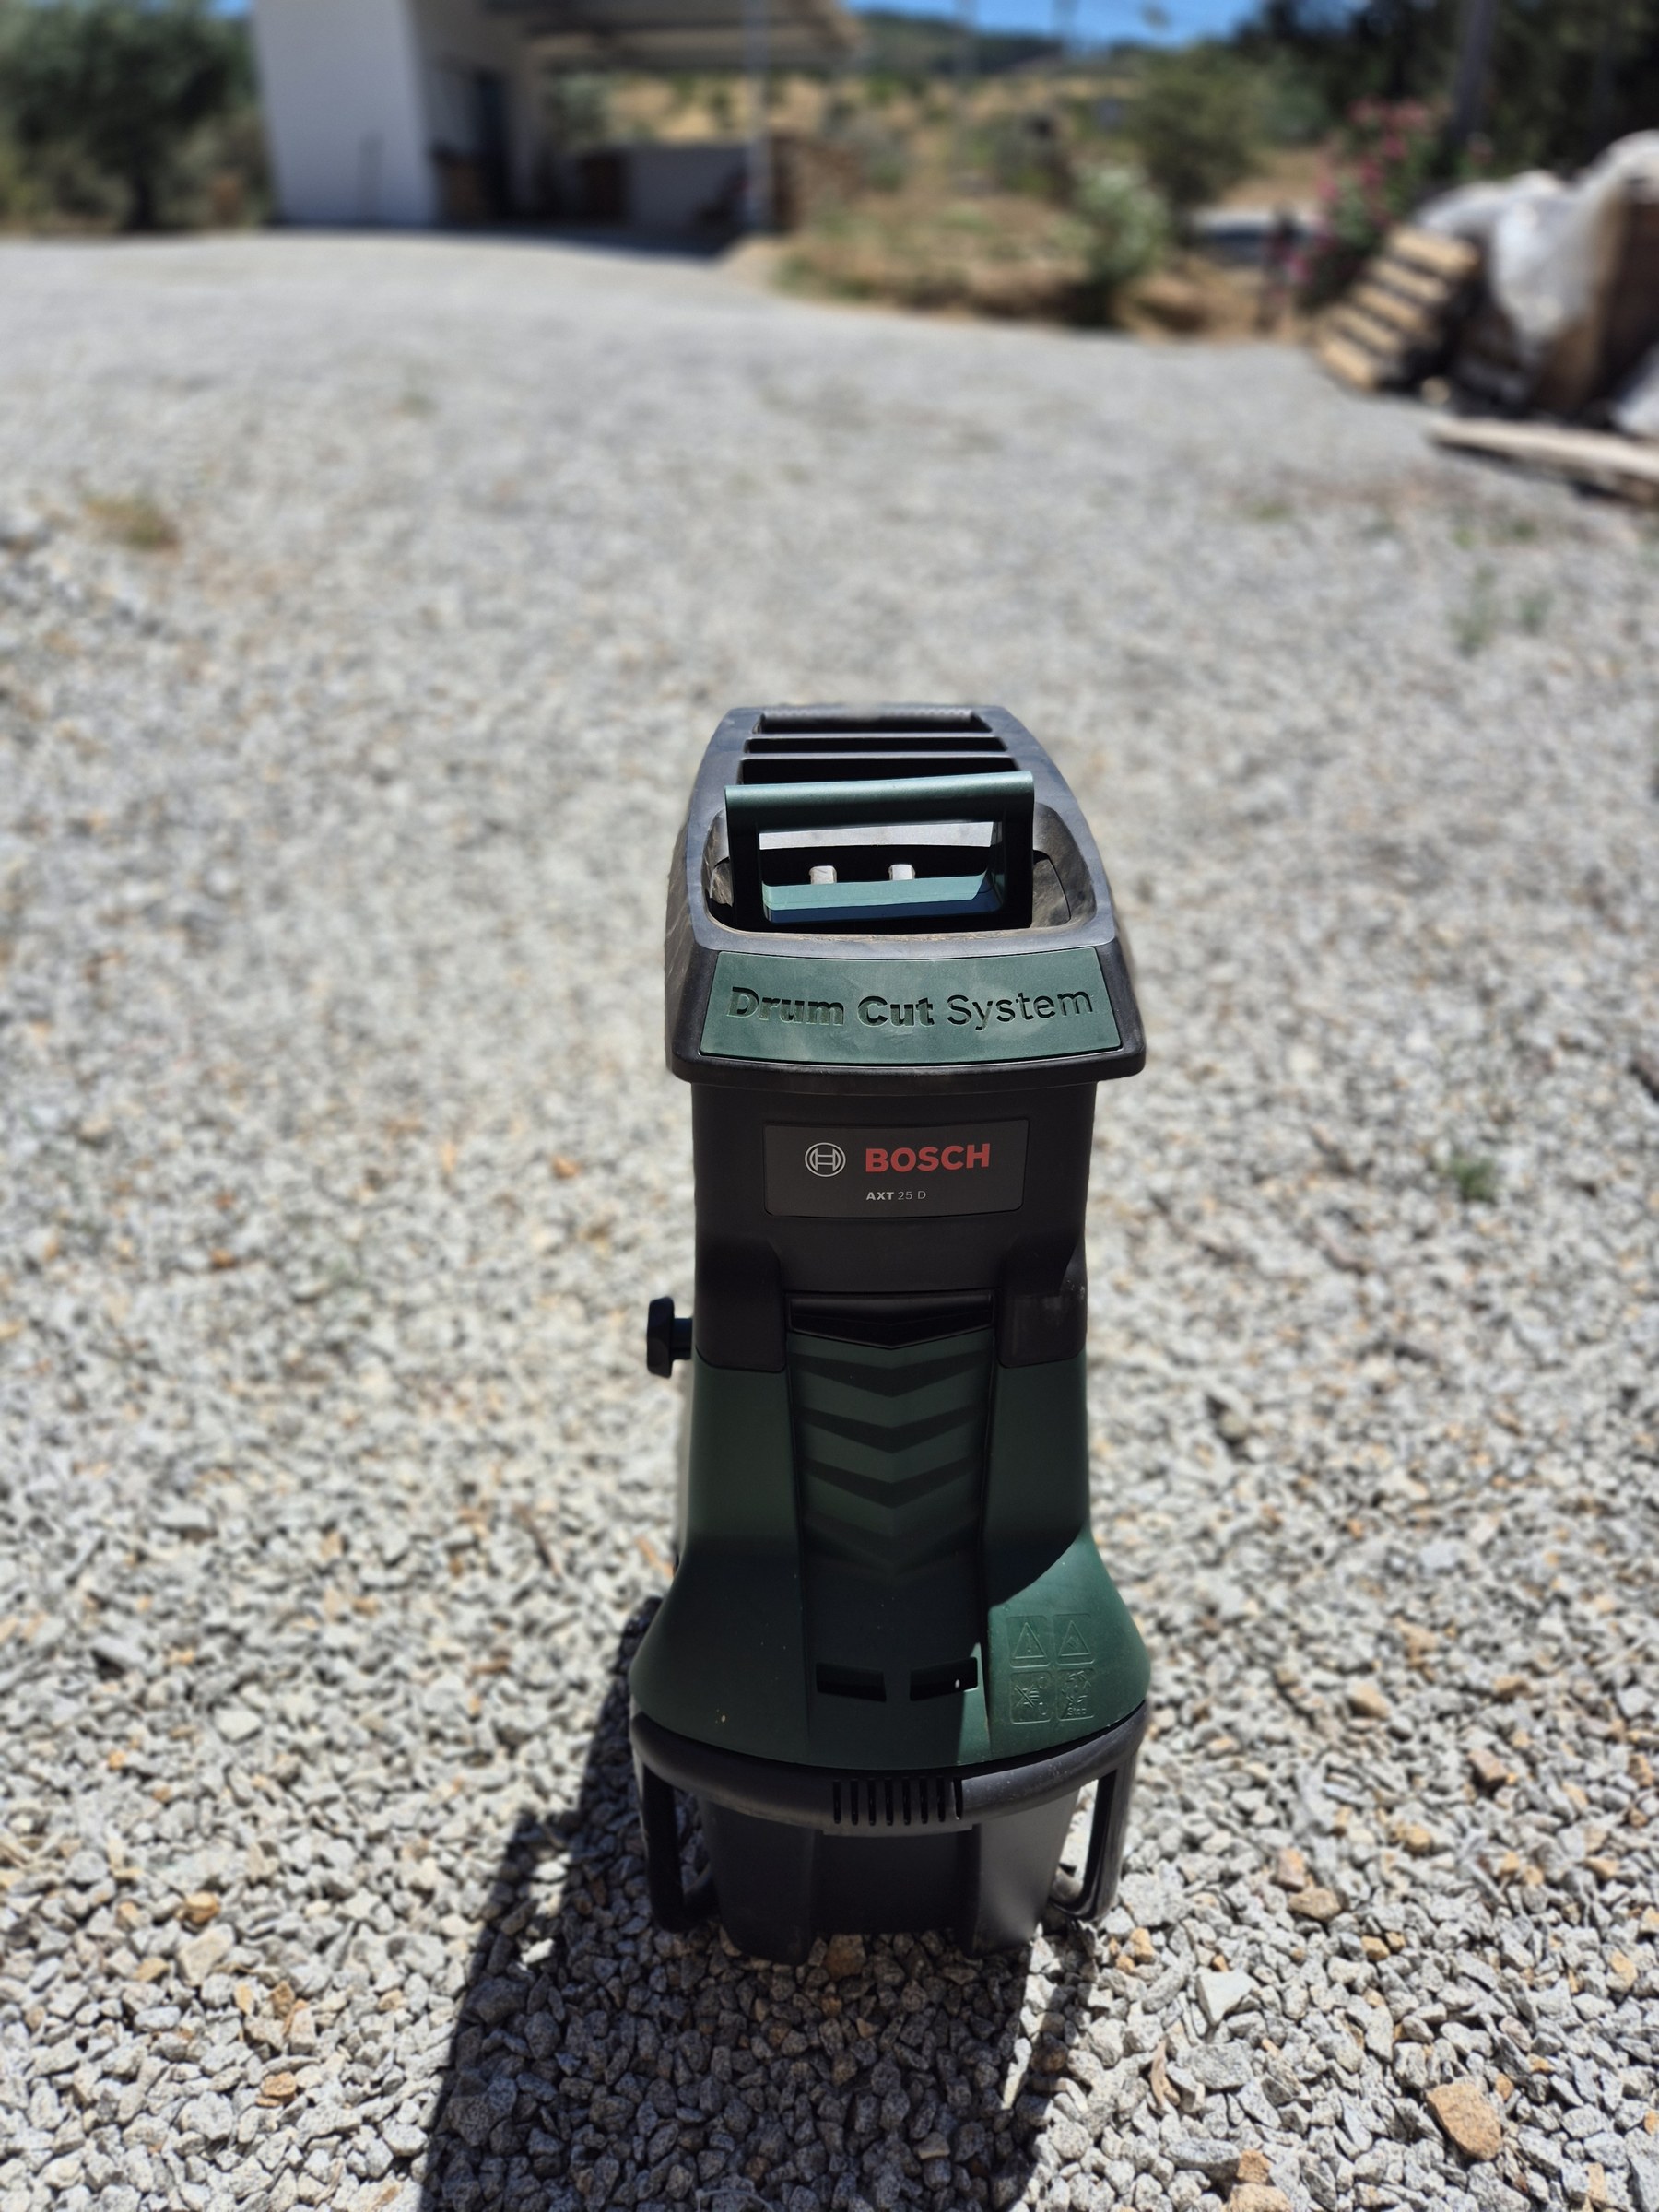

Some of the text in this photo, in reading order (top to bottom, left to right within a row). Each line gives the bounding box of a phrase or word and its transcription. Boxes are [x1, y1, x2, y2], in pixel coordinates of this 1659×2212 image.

[725, 985, 1094, 1031] Drum Cut System
[865, 1143, 991, 1172] BOSCH
[865, 1190, 927, 1201] AXT 25 D
